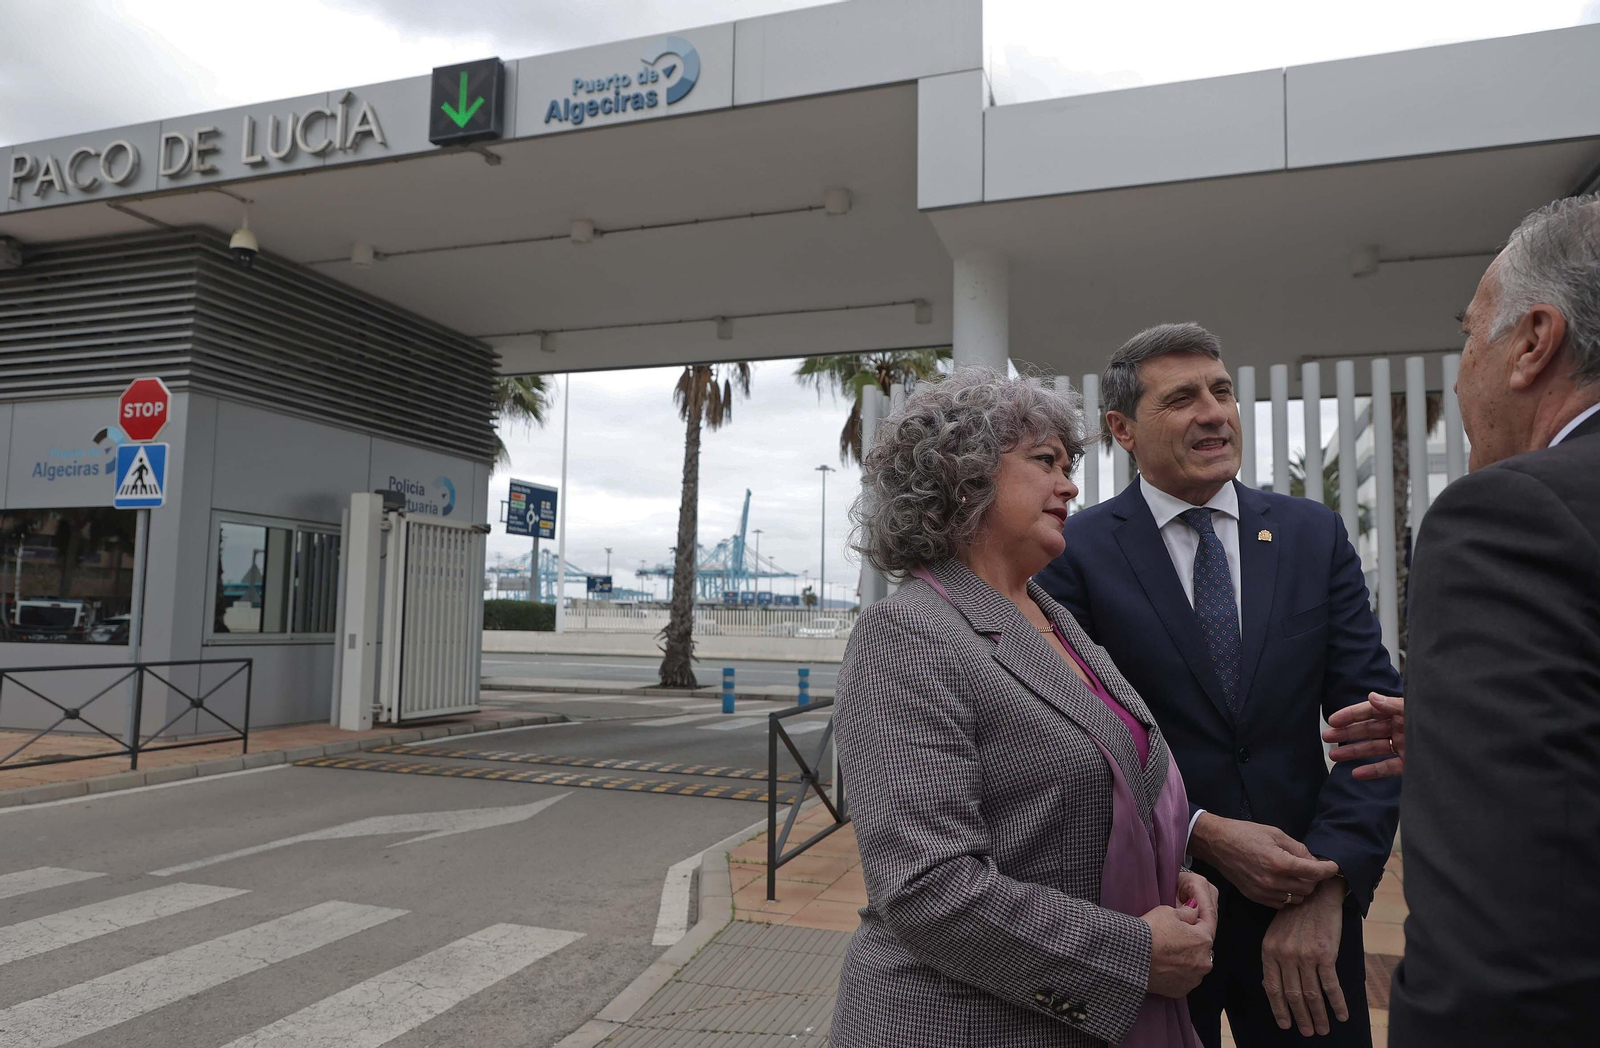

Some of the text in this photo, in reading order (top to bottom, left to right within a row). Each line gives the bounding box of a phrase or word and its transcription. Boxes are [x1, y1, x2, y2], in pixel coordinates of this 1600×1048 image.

[572, 67, 659, 95] Puerto de
[544, 90, 659, 125] Algeciras
[9, 90, 387, 199] PACO DE LUCÍA
[123, 401, 165, 418] STOP
[32, 460, 100, 481] Algeciras
[405, 498, 438, 515] tuaria
